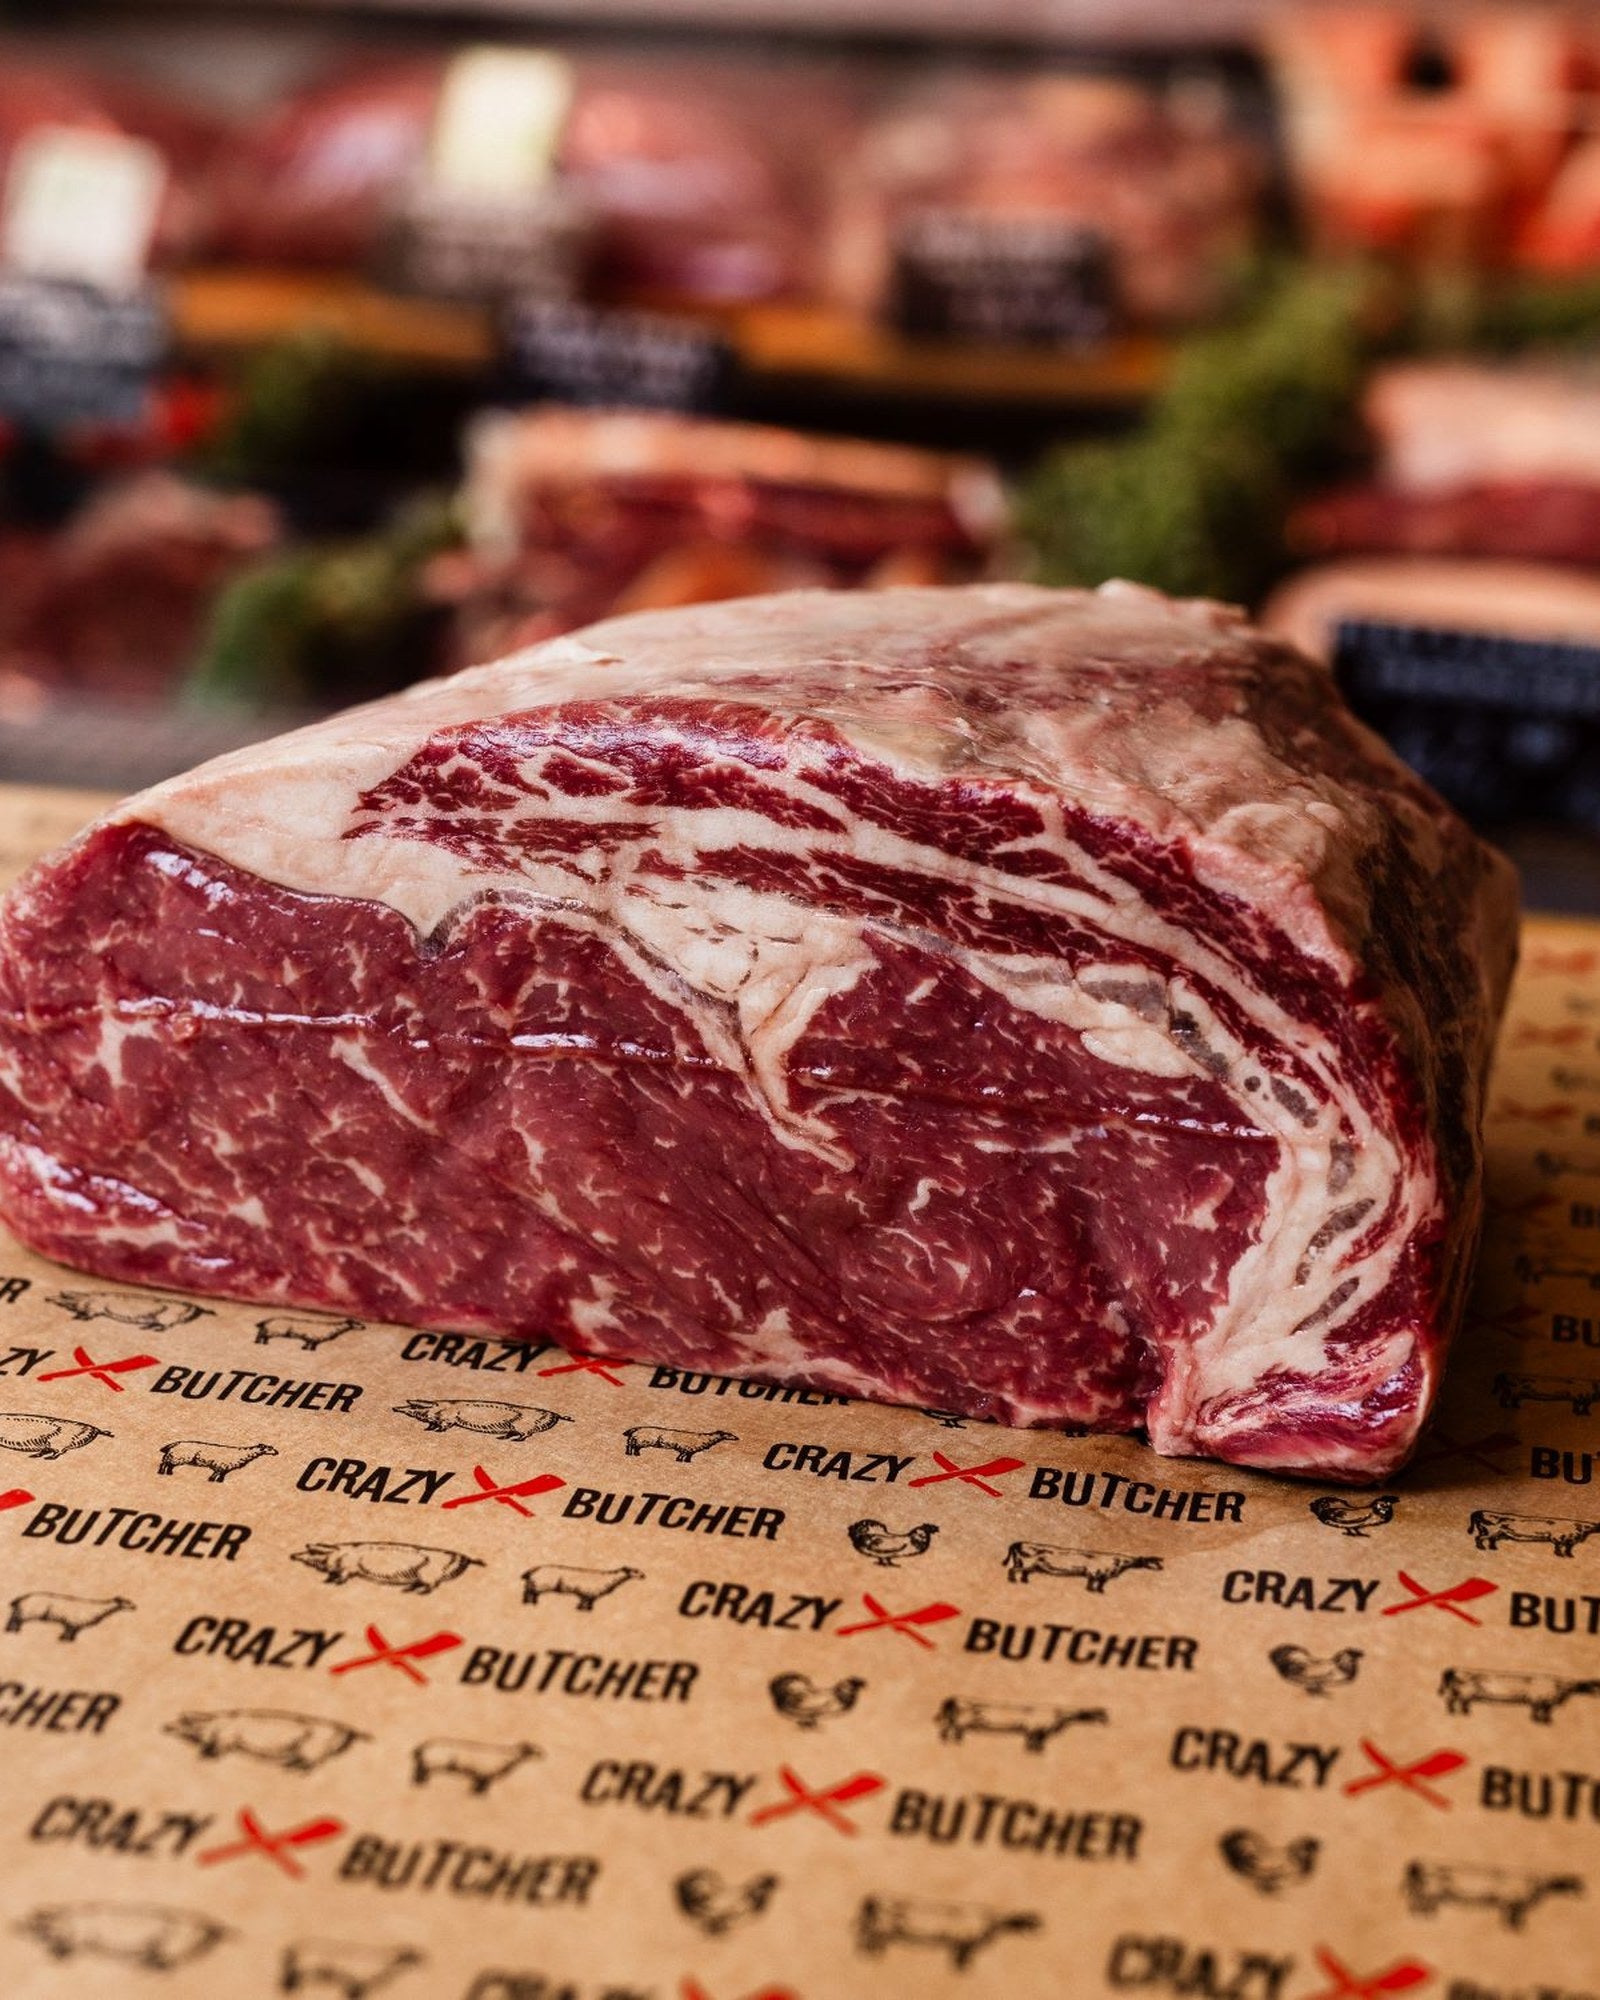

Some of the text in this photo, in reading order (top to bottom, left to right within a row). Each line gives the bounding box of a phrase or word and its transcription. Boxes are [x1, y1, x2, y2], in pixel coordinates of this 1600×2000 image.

[150, 1365, 364, 1413] BUTCHER
[400, 1332, 553, 1373] CRAZY
[296, 1456, 786, 1541] CRAZY BUTCHER
[762, 1442, 1600, 1524] CRAZY BUTCHER BU
[21, 1502, 252, 1562] BUTCHER
[678, 1580, 1199, 1672] CRAZY BUTCHER
[1222, 1569, 1382, 1613] CRAZY
[173, 1614, 700, 1703] CRAZY BUTCHER
[1170, 1726, 1340, 1788] CRAZY
[30, 1796, 601, 1906] CRAZY BUTCHER
[580, 1759, 1143, 1862] CRAZY BUTCHER
